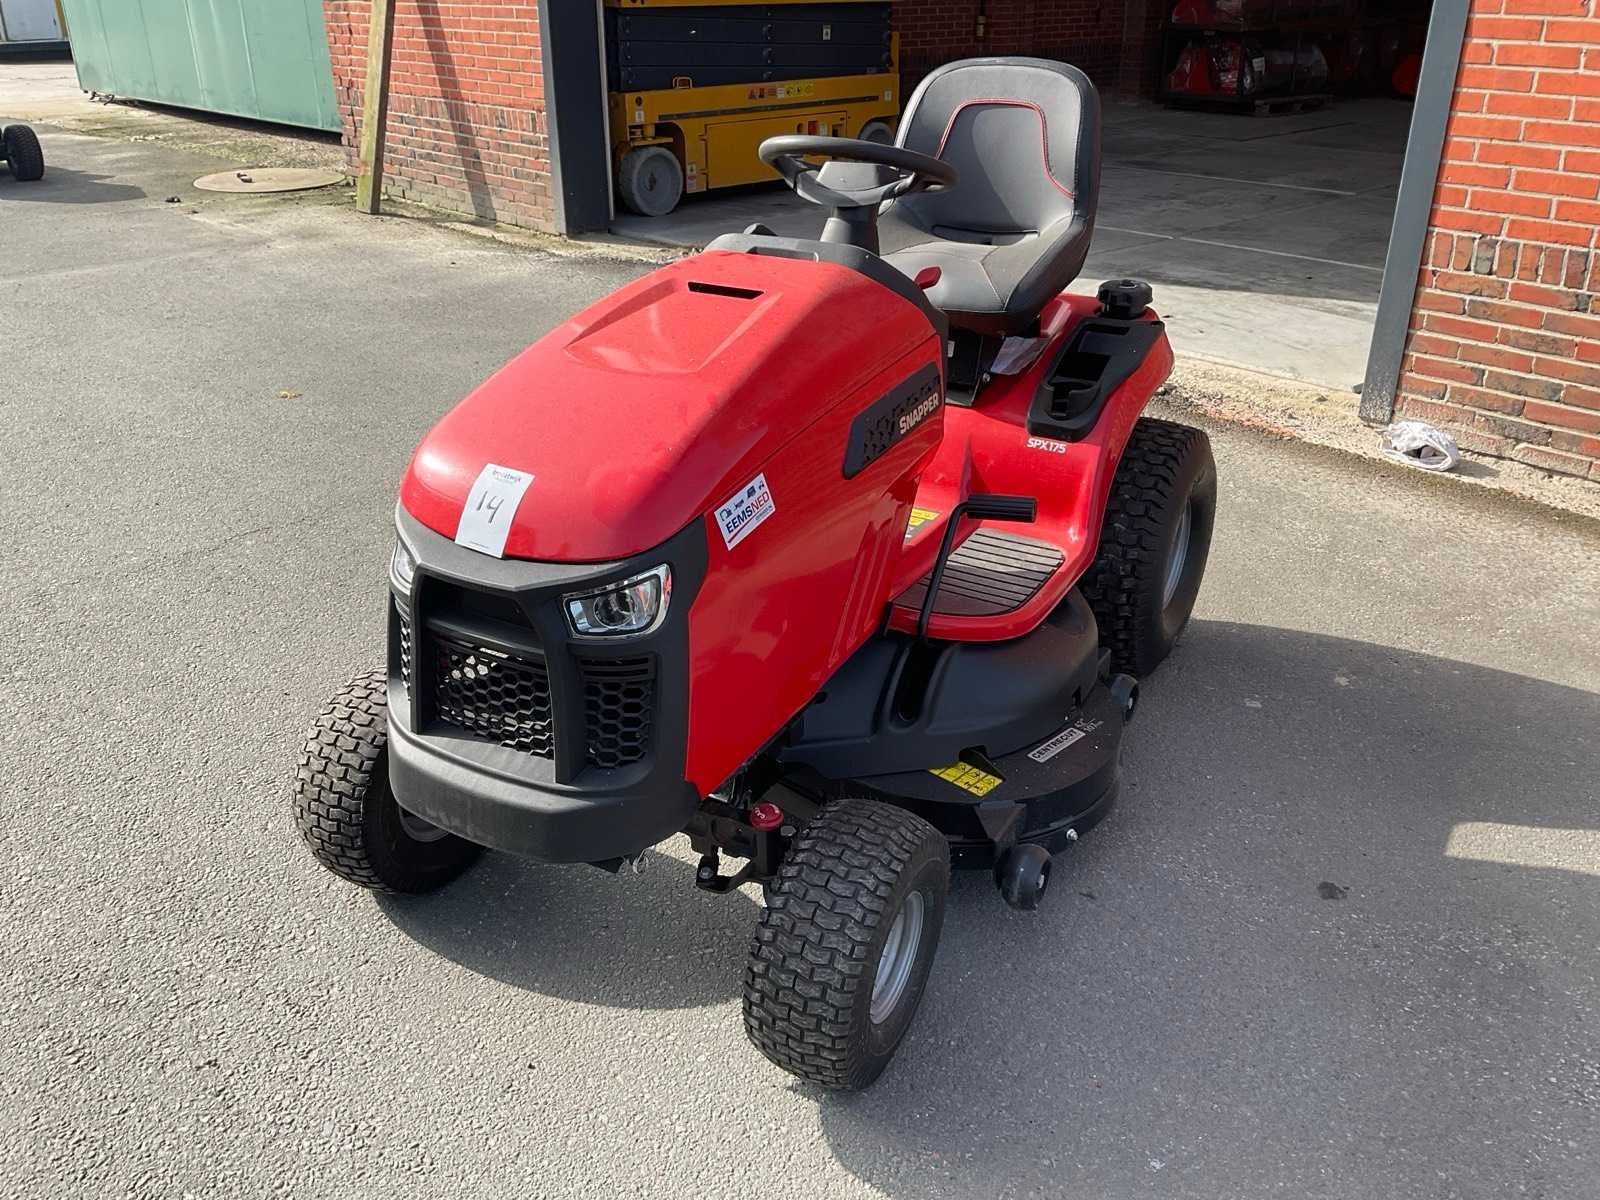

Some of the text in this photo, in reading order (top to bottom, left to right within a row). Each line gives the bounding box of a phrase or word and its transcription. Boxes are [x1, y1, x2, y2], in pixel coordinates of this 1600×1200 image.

[899, 392, 939, 434] SNAPPER
[476, 490, 504, 524] 14
[725, 491, 769, 534] EEMSNED
[1031, 728, 1078, 759] CENTRECUT
